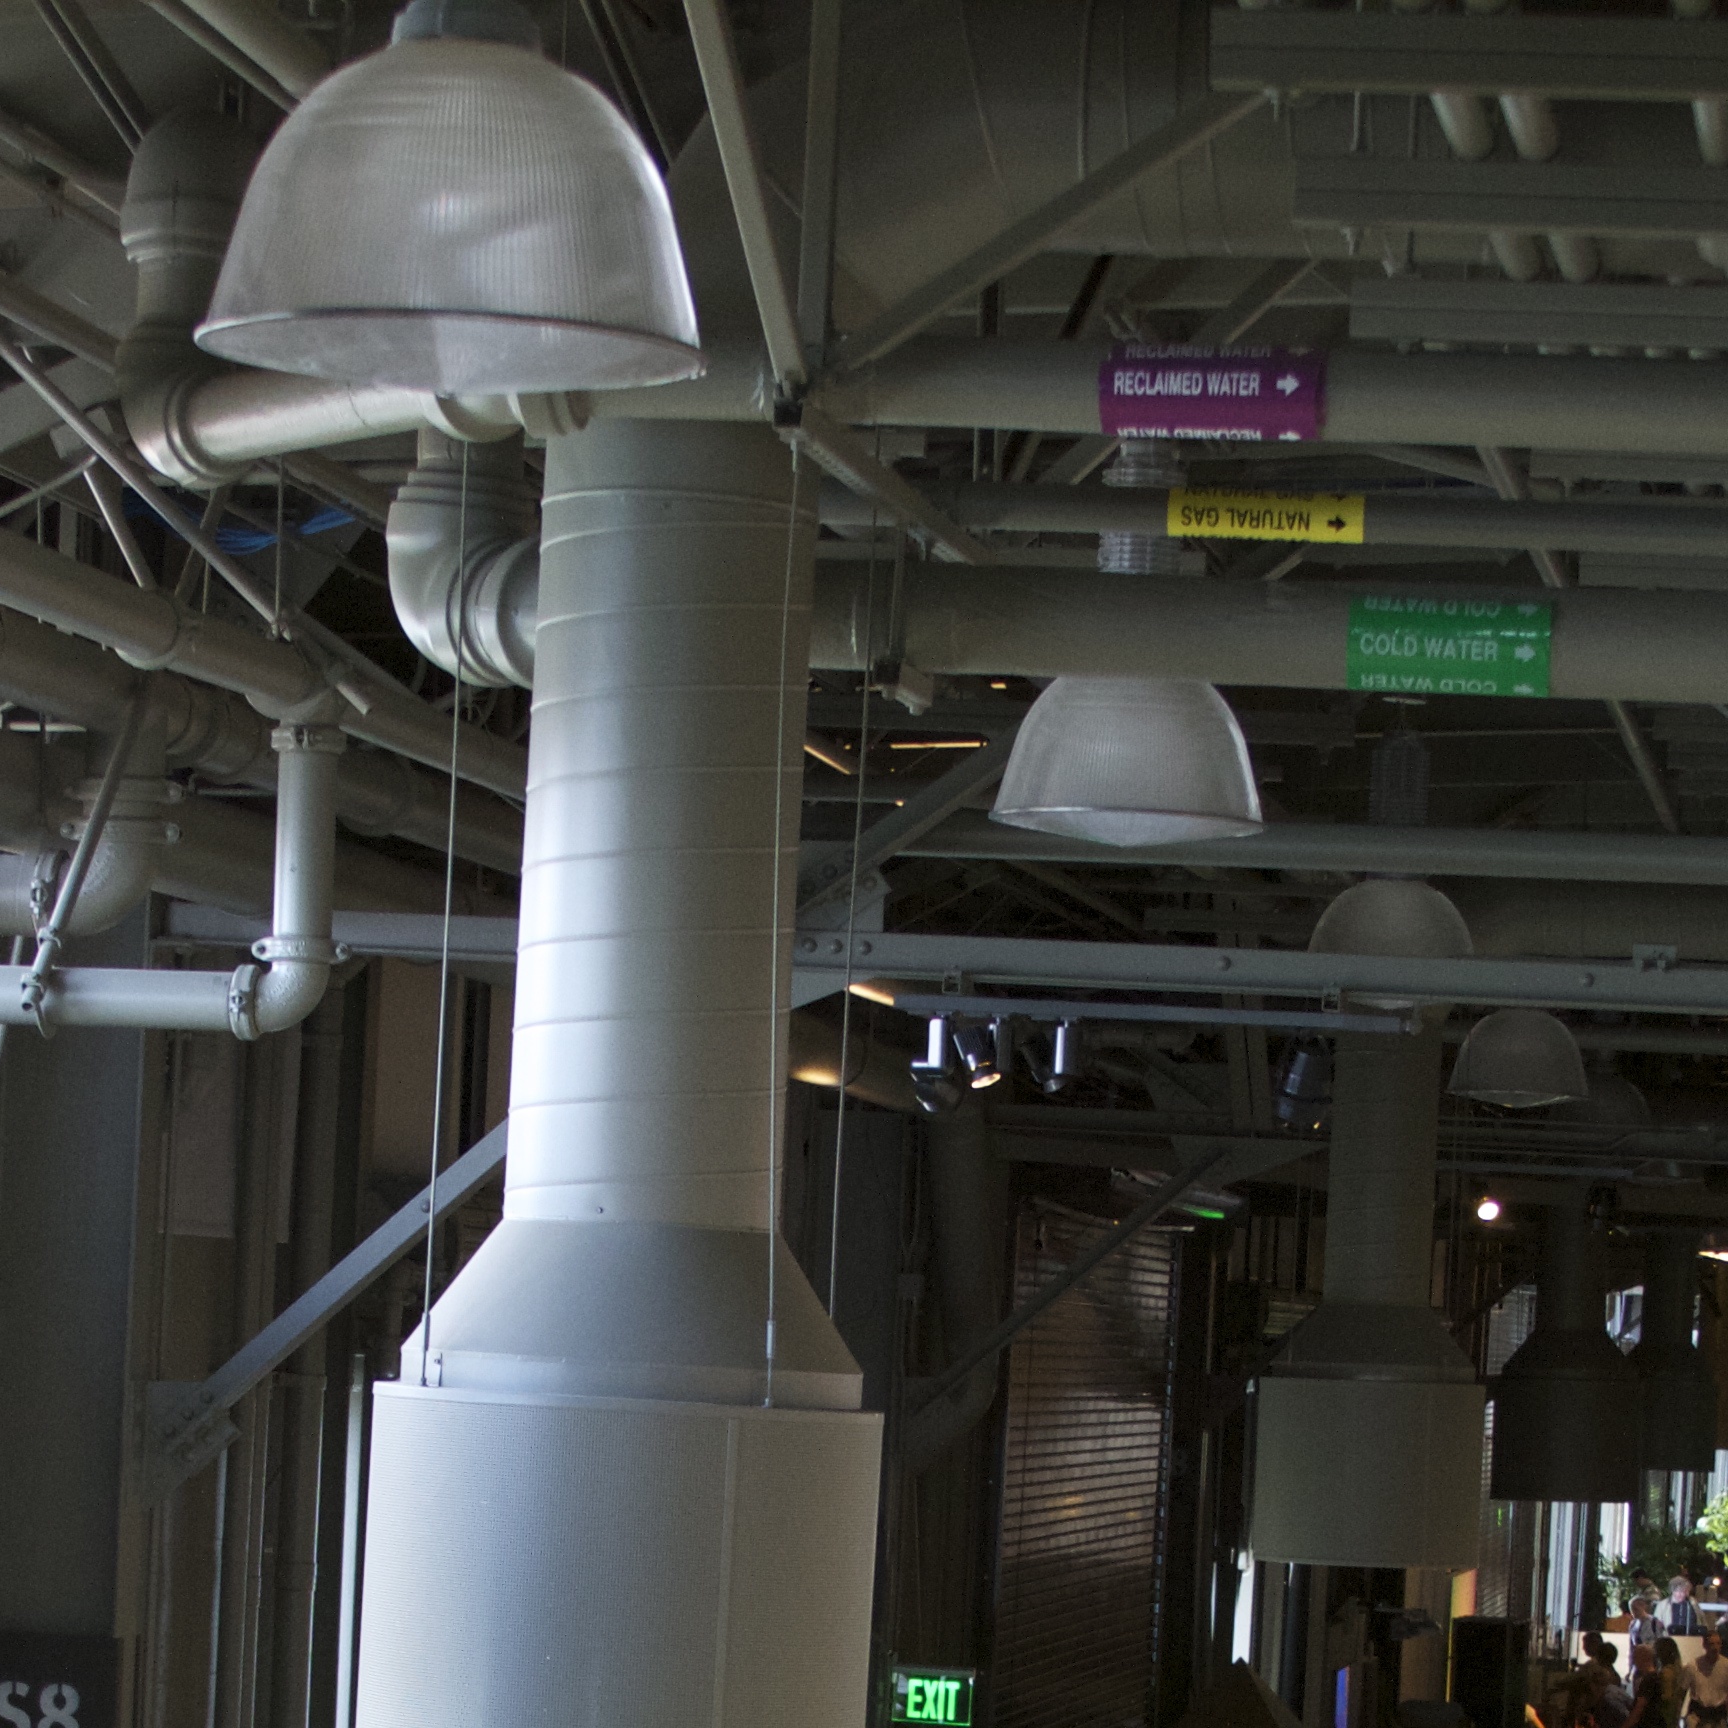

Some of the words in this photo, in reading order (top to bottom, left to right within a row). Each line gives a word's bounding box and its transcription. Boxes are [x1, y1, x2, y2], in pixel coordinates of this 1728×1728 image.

[1113, 370, 1203, 396] RECLAIMED
[1206, 371, 1260, 396] WATER
[1181, 504, 1220, 527] GAS
[1224, 505, 1311, 532] NATURAL
[1359, 633, 1418, 657] COLD
[1422, 637, 1499, 661] WATER
[1360, 673, 1434, 692] WATER
[1439, 678, 1498, 694] COLD
[906, 1677, 962, 1722] EXIT
